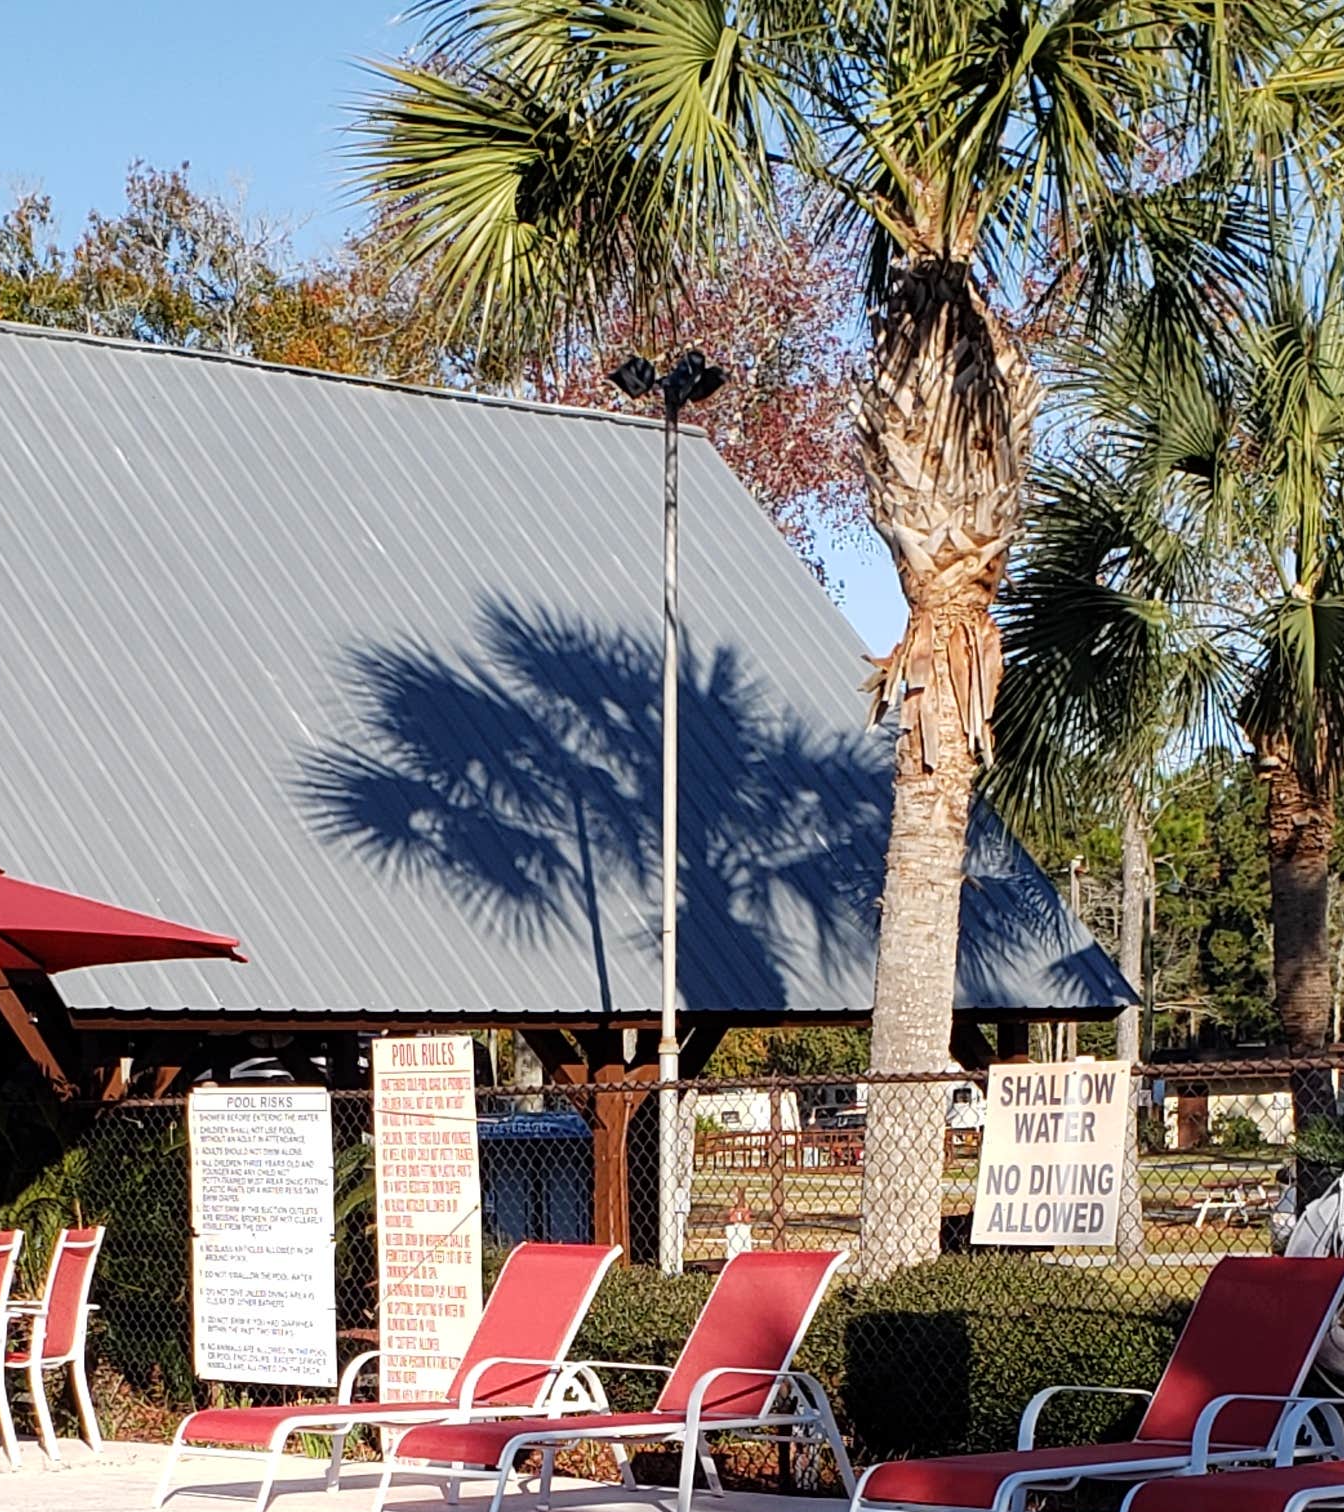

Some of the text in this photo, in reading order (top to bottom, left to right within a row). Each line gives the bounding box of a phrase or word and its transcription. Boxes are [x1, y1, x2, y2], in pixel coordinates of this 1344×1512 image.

[392, 1042, 455, 1067] POOL RULES
[227, 1096, 293, 1108] POOL RISKS
[1000, 1073, 1116, 1107] SHALLOW
[1015, 1112, 1096, 1143] WATER
[986, 1163, 1114, 1195] NO DIVING
[987, 1202, 1104, 1233] ALLOWED
